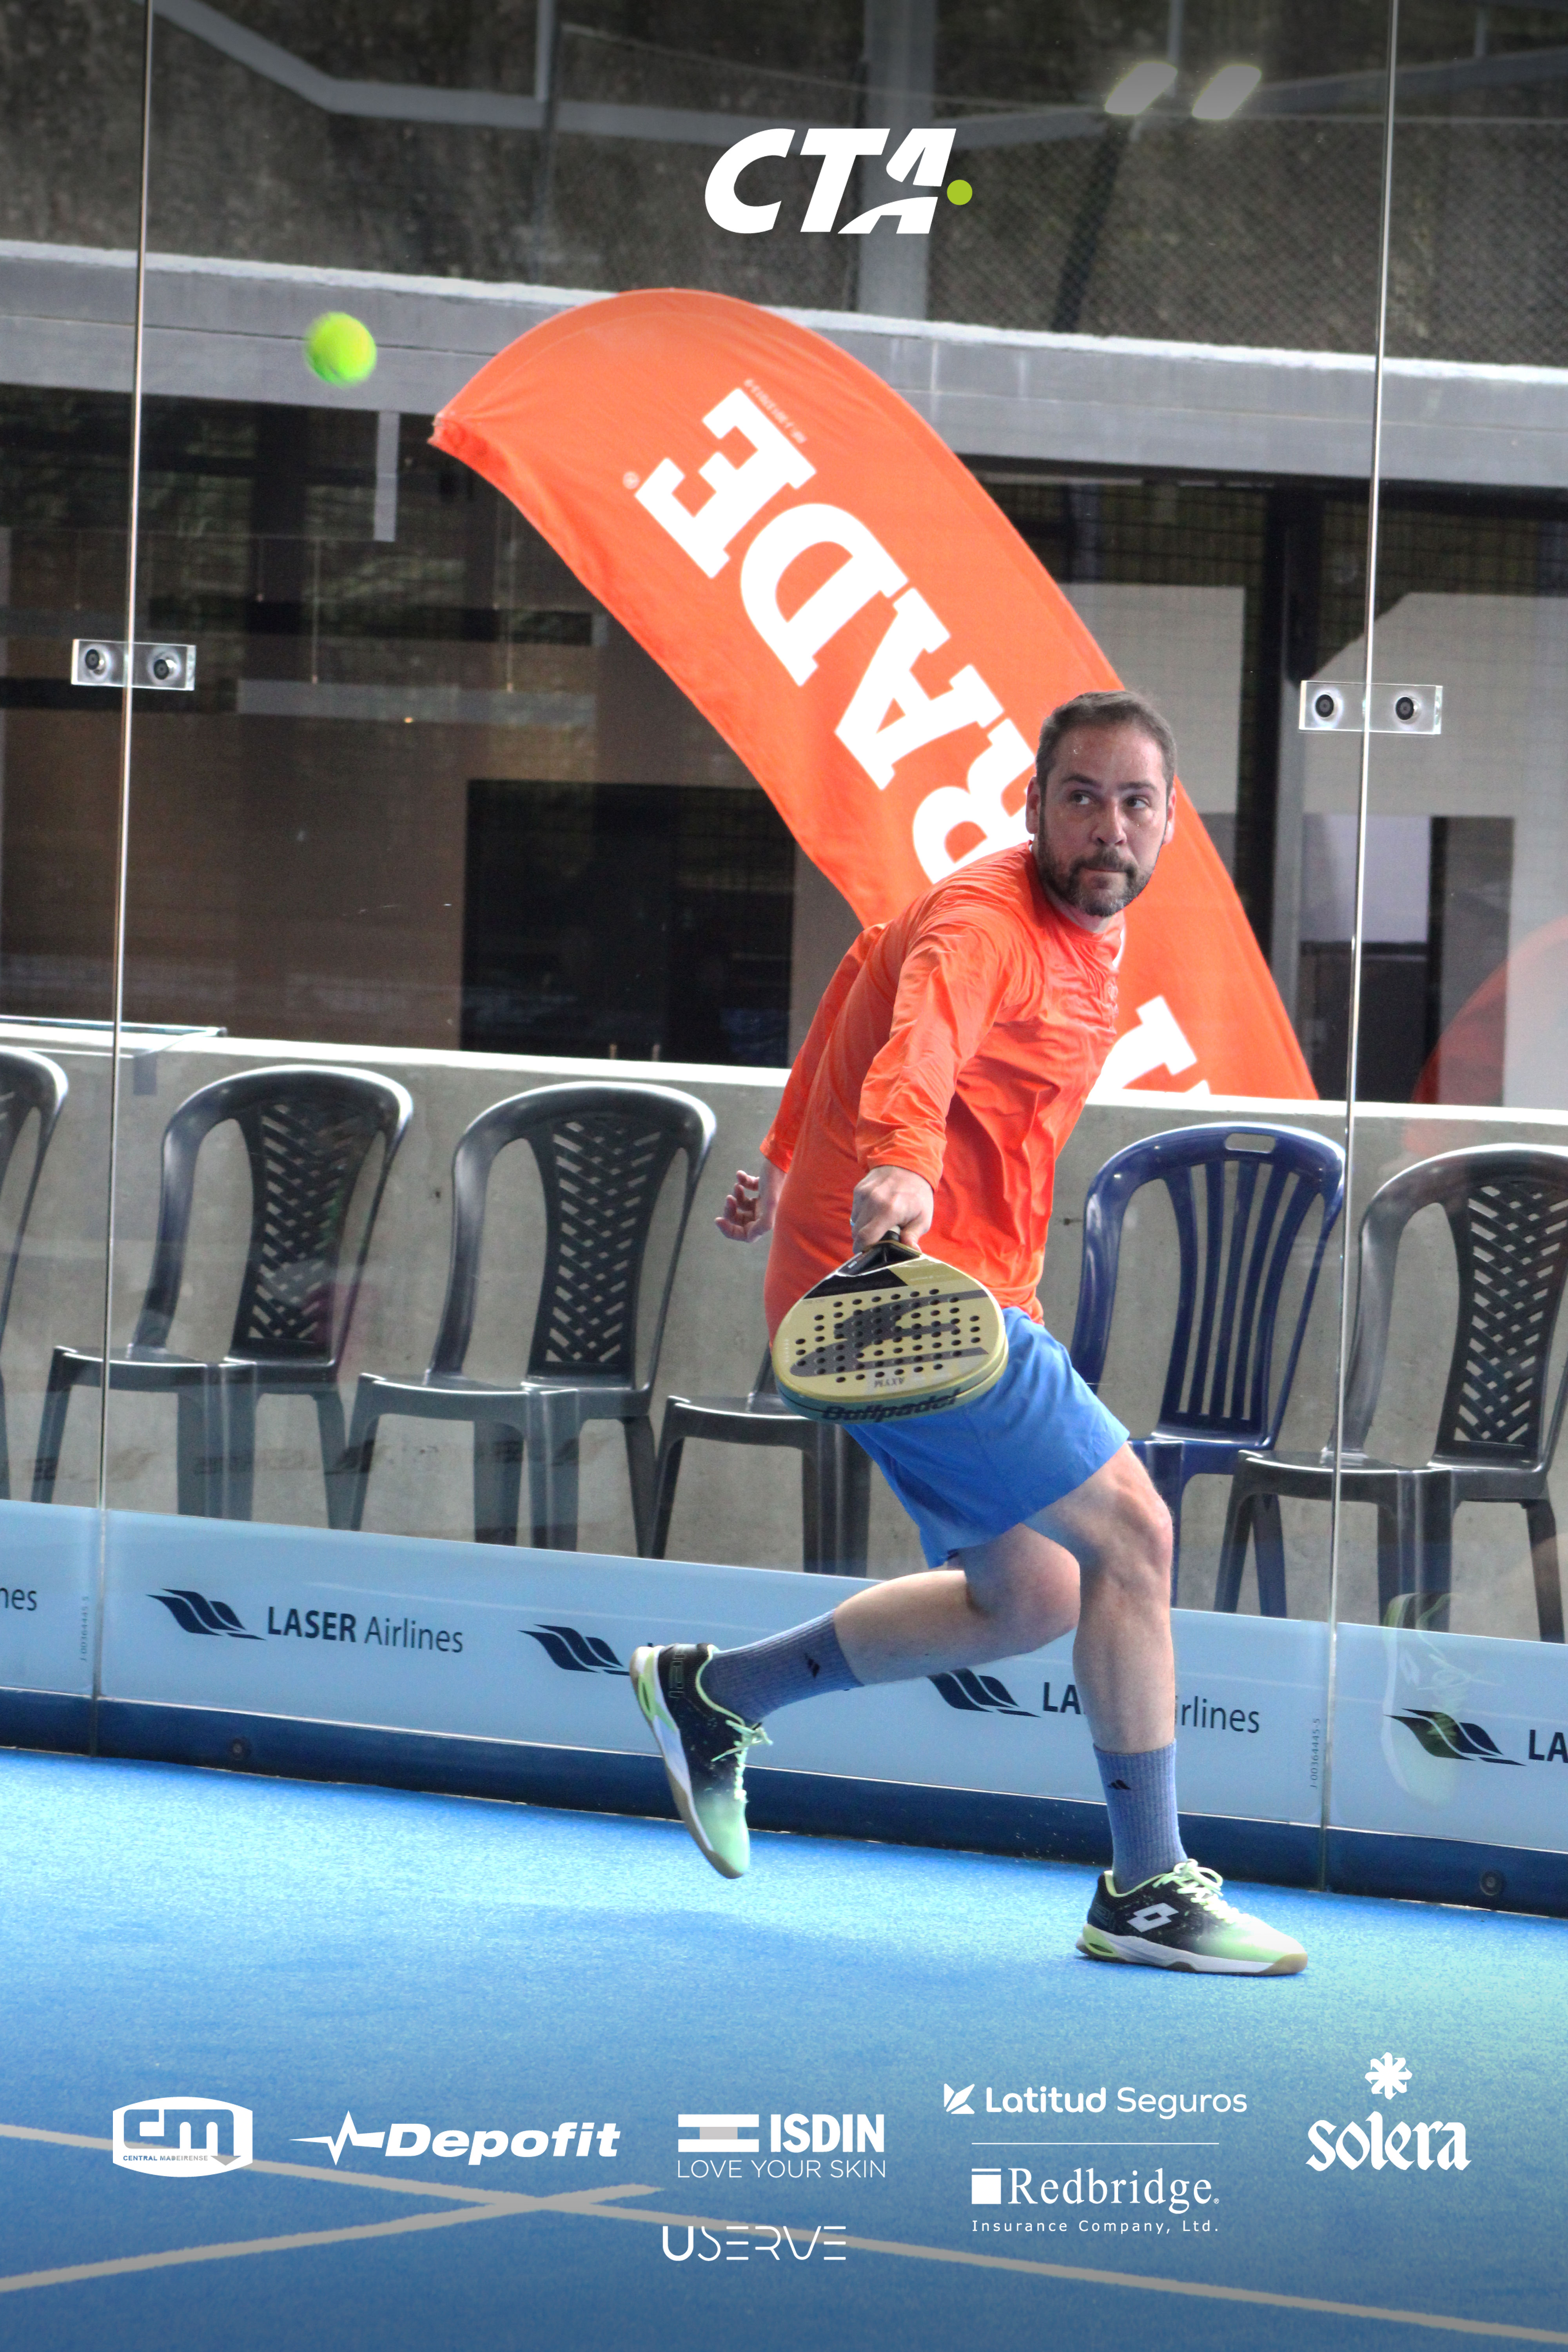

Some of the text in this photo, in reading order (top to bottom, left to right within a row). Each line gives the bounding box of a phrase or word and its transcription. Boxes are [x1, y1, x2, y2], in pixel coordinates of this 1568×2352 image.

[268, 1606, 463, 1653] LASER Airlines
[1175, 1695, 1259, 1733] rlines
